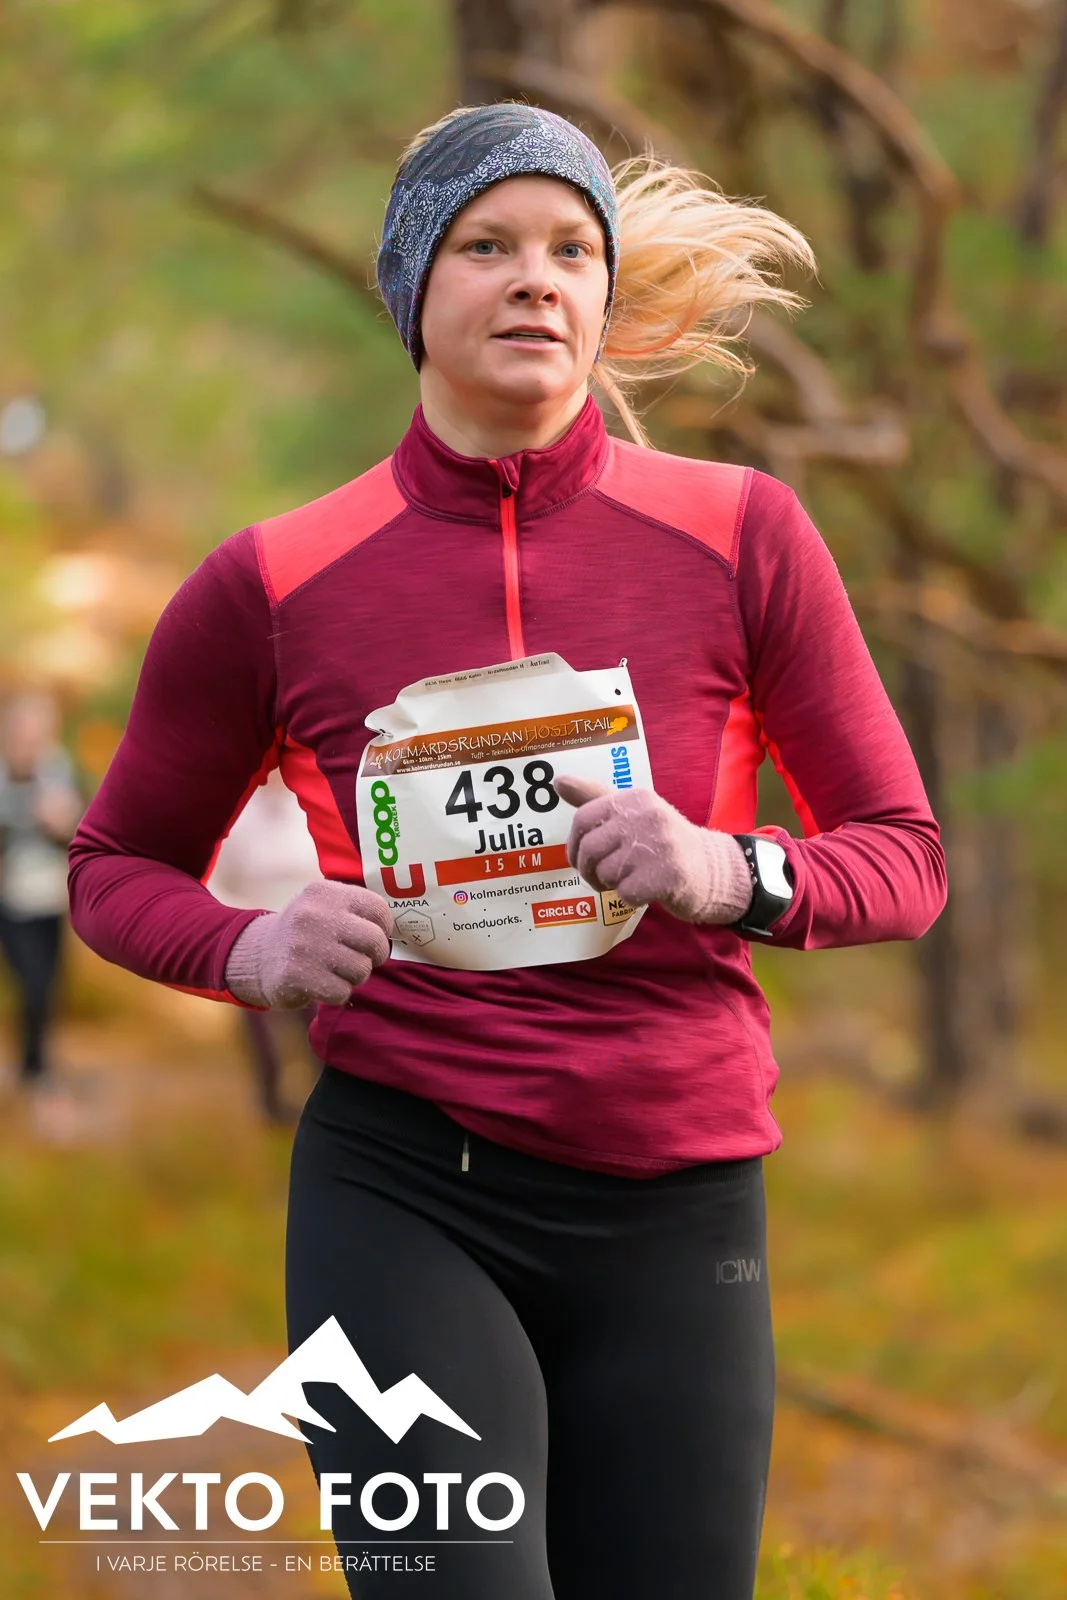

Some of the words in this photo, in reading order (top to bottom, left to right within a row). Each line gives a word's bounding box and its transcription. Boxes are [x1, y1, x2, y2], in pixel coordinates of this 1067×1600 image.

[611, 746, 632, 789] itus
[445, 760, 560, 823] 438
[475, 823, 544, 854] Julia
[484, 858, 505, 873] 15
[519, 853, 542, 868] KM
[470, 876, 580, 900] kolmardsrundantrail
[538, 905, 575, 918] CIRCLE
